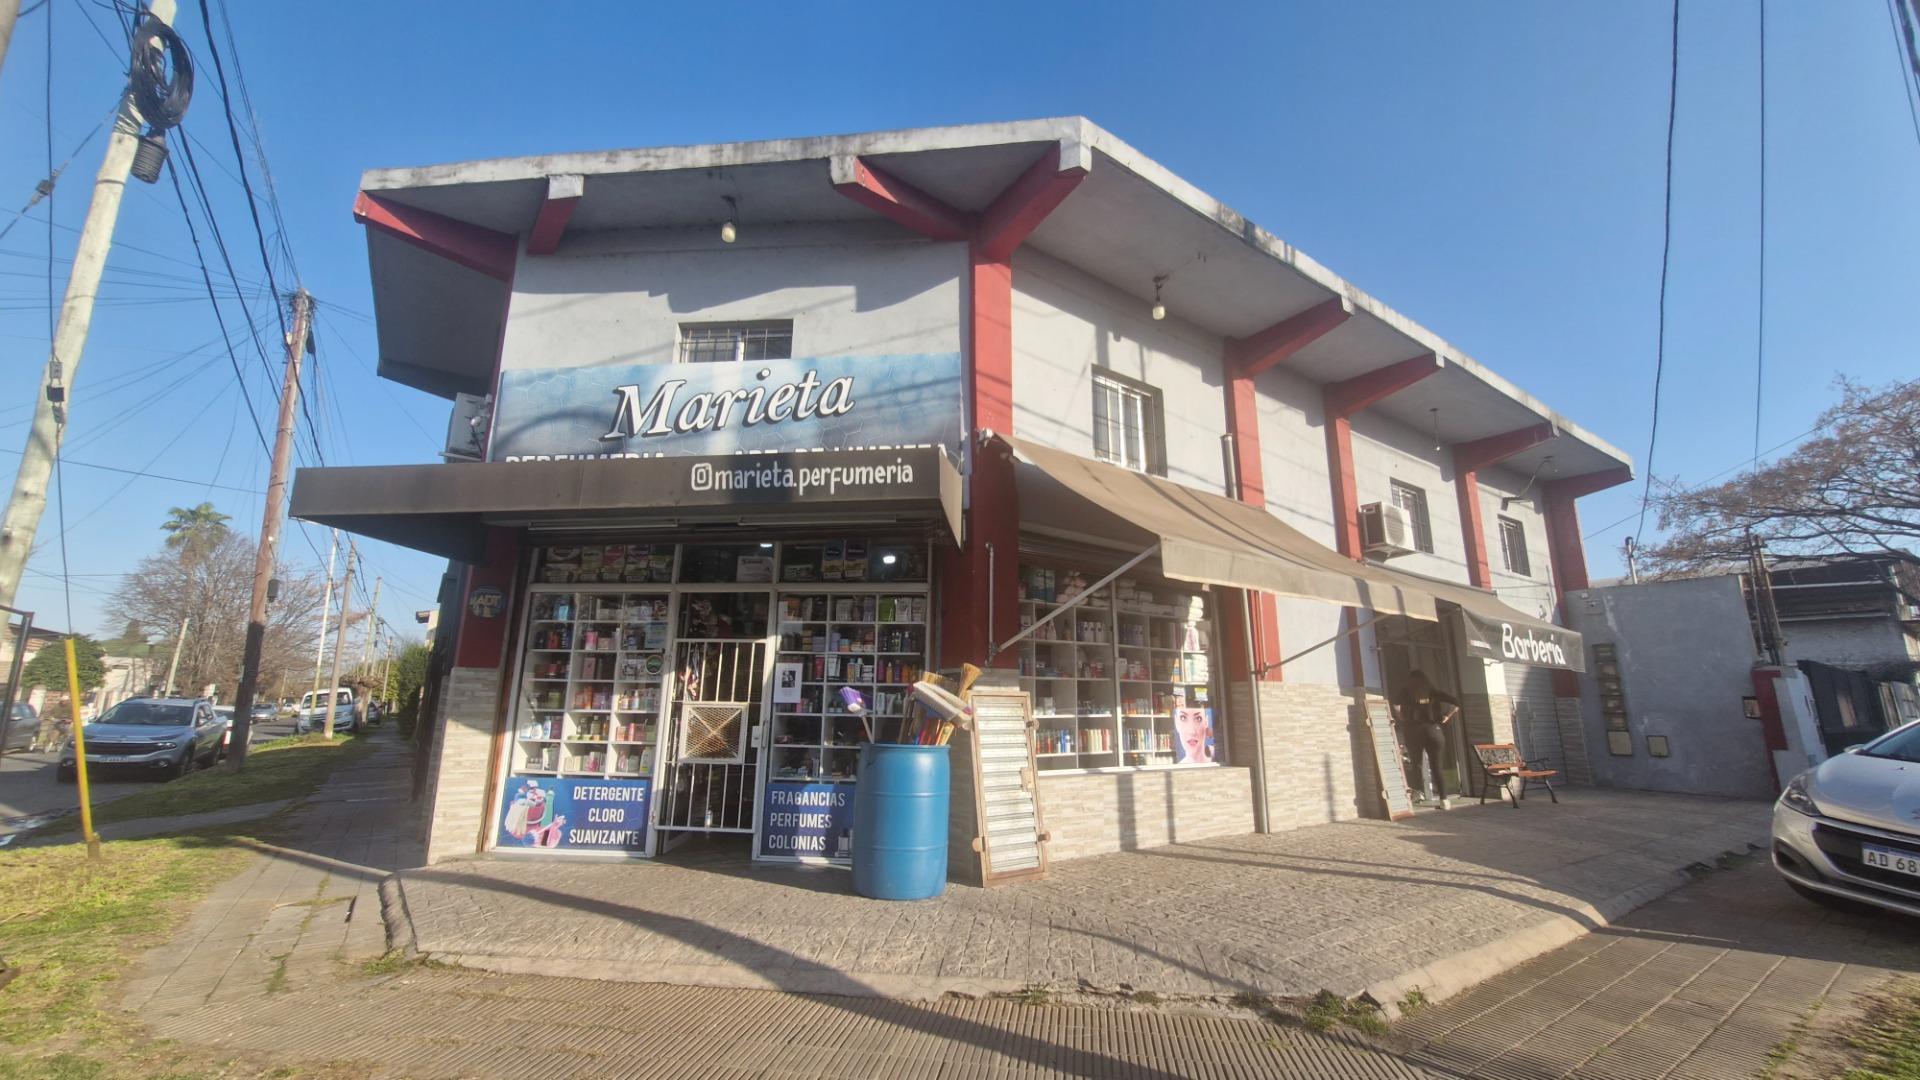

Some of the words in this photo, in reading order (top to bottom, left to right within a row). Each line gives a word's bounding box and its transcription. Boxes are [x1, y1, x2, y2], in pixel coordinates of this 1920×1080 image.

[601, 368, 855, 440] Marieta
[714, 457, 914, 496] marieta.perfumeria
[1502, 622, 1566, 665] Barberia
[573, 786, 645, 801] DETERGENTE
[771, 790, 846, 807] FRAGANCIAS
[588, 808, 625, 823] CLORO
[769, 812, 832, 828] PERFUMES
[568, 829, 639, 845] SUAVIZANTE
[768, 834, 826, 850] COLONIAS
[1867, 851, 1889, 867] AD
[1896, 857, 1920, 873] 68
